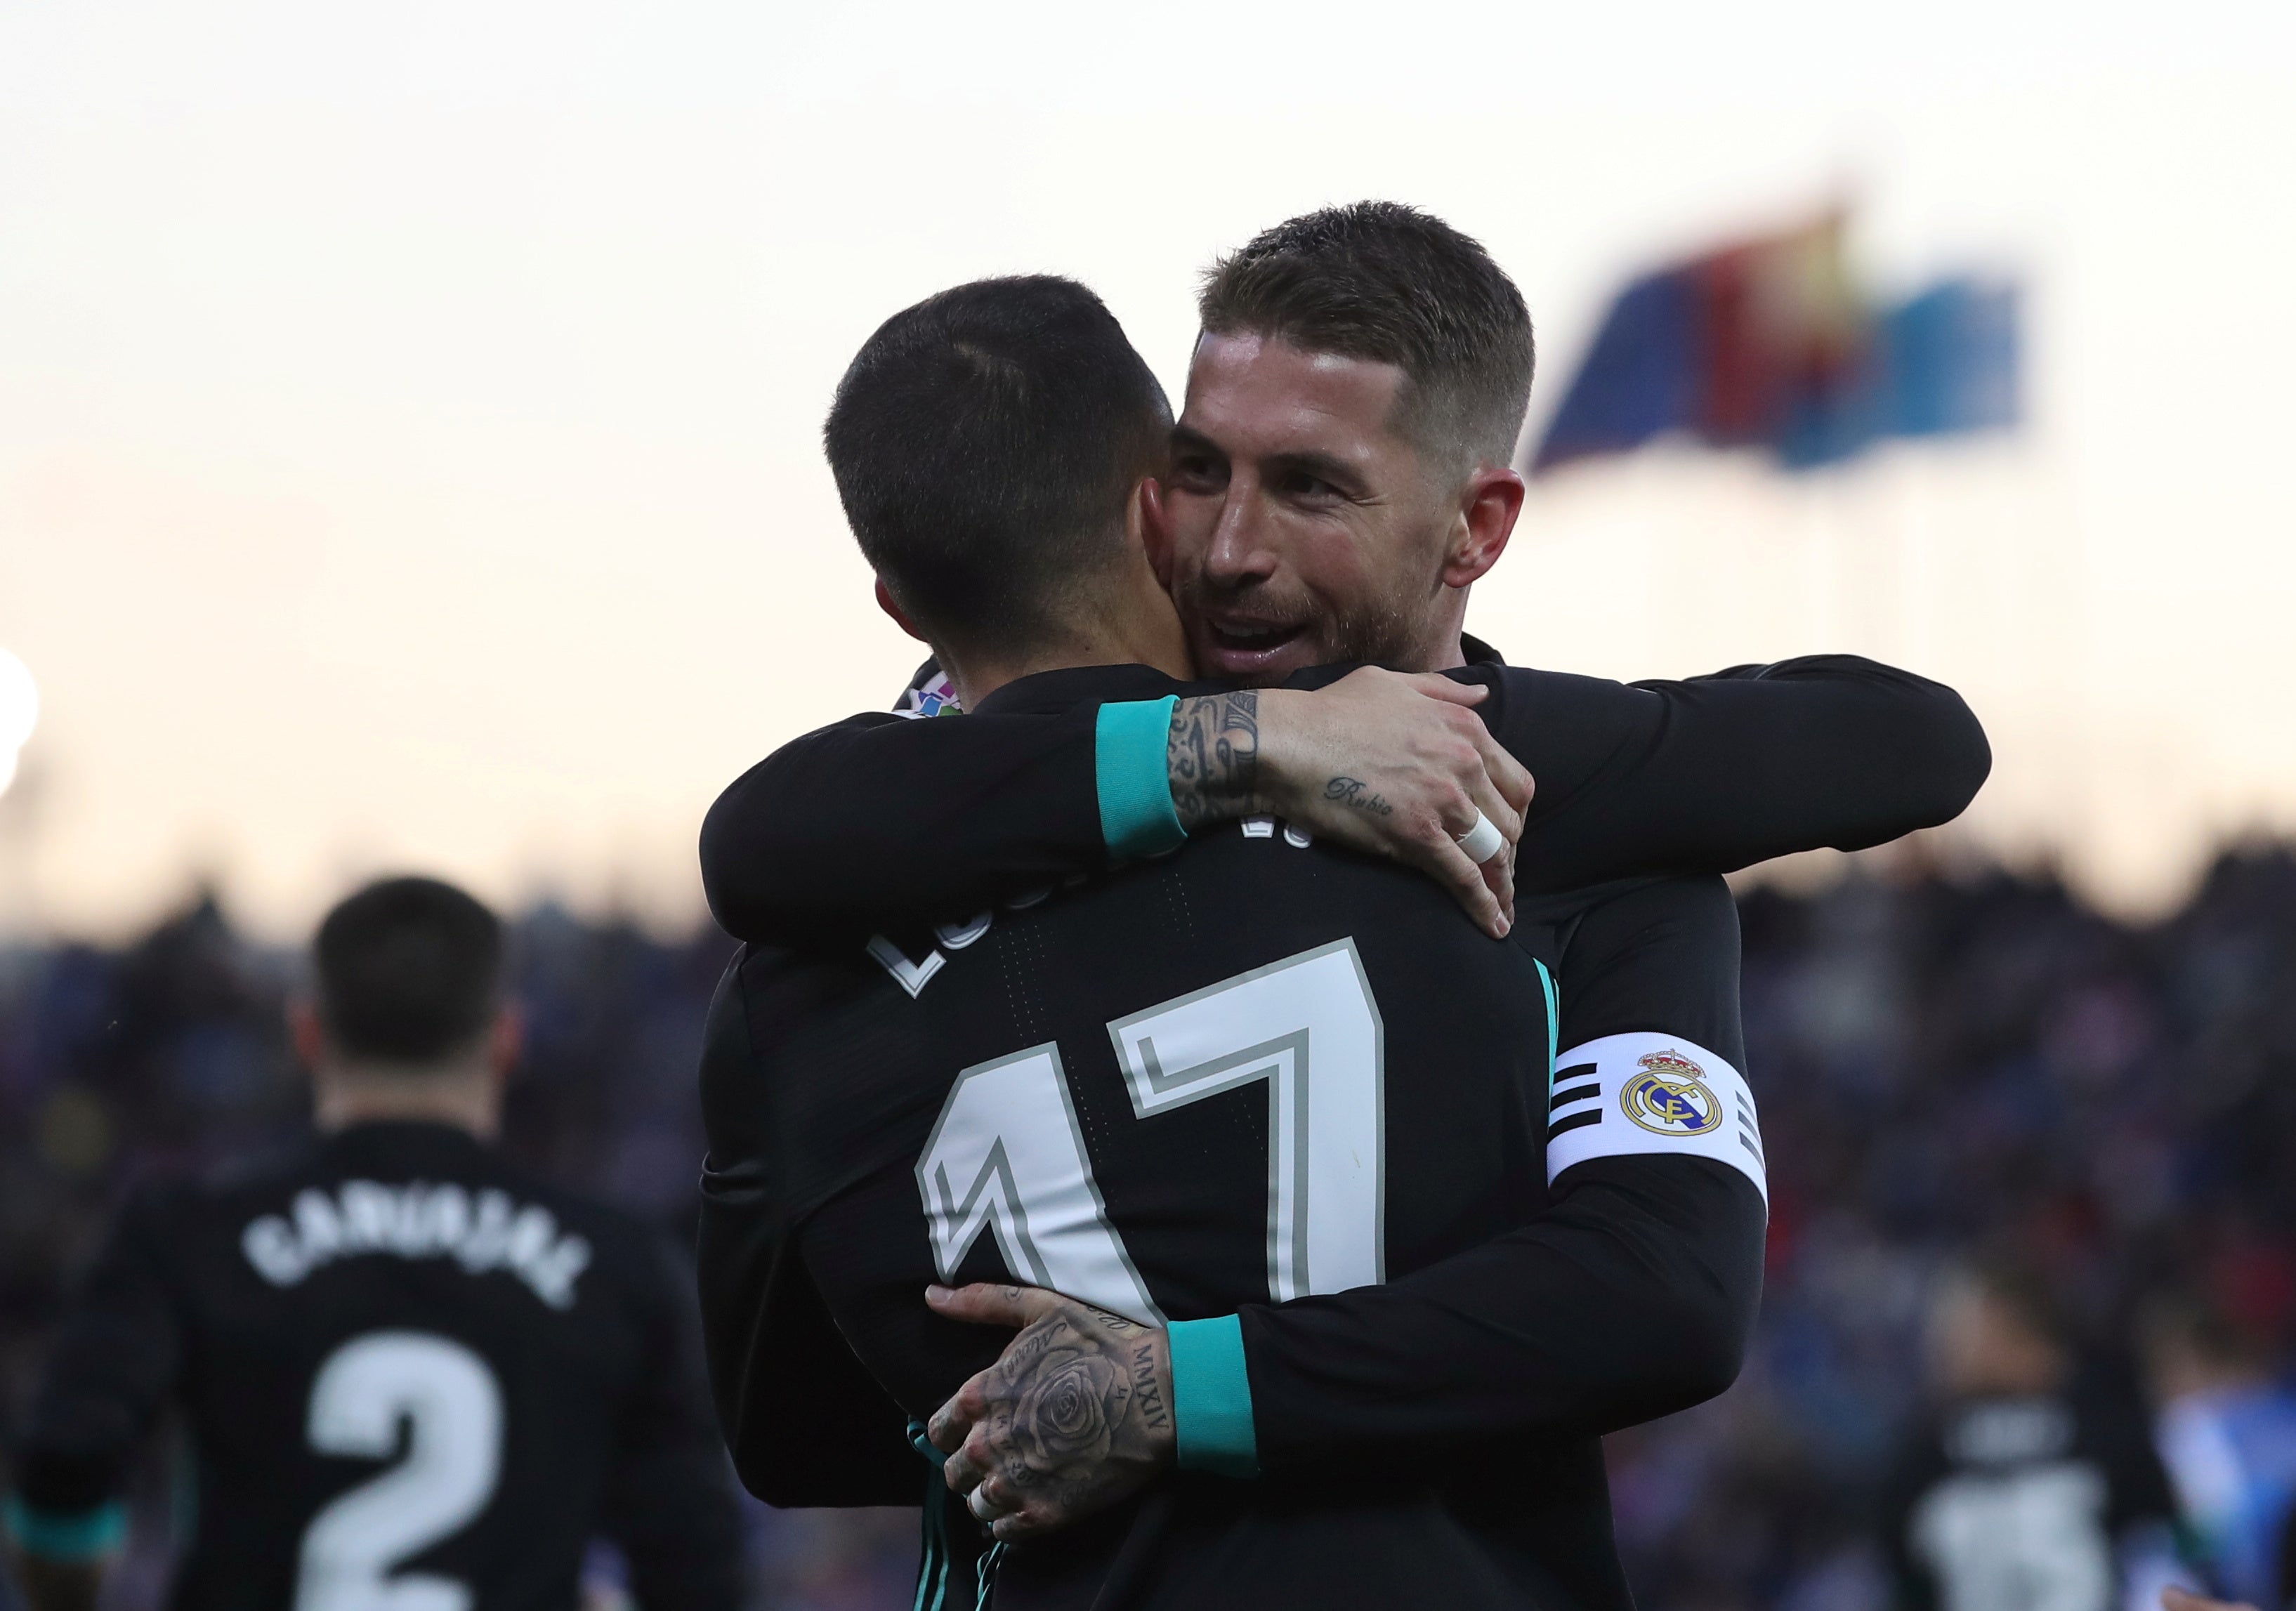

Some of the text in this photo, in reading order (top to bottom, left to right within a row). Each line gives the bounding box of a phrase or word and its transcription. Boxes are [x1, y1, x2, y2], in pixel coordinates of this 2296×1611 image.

[914, 936, 1385, 1329] 17
[295, 1332, 506, 1611] 2
[1133, 1344, 1169, 1431] MMXIV
